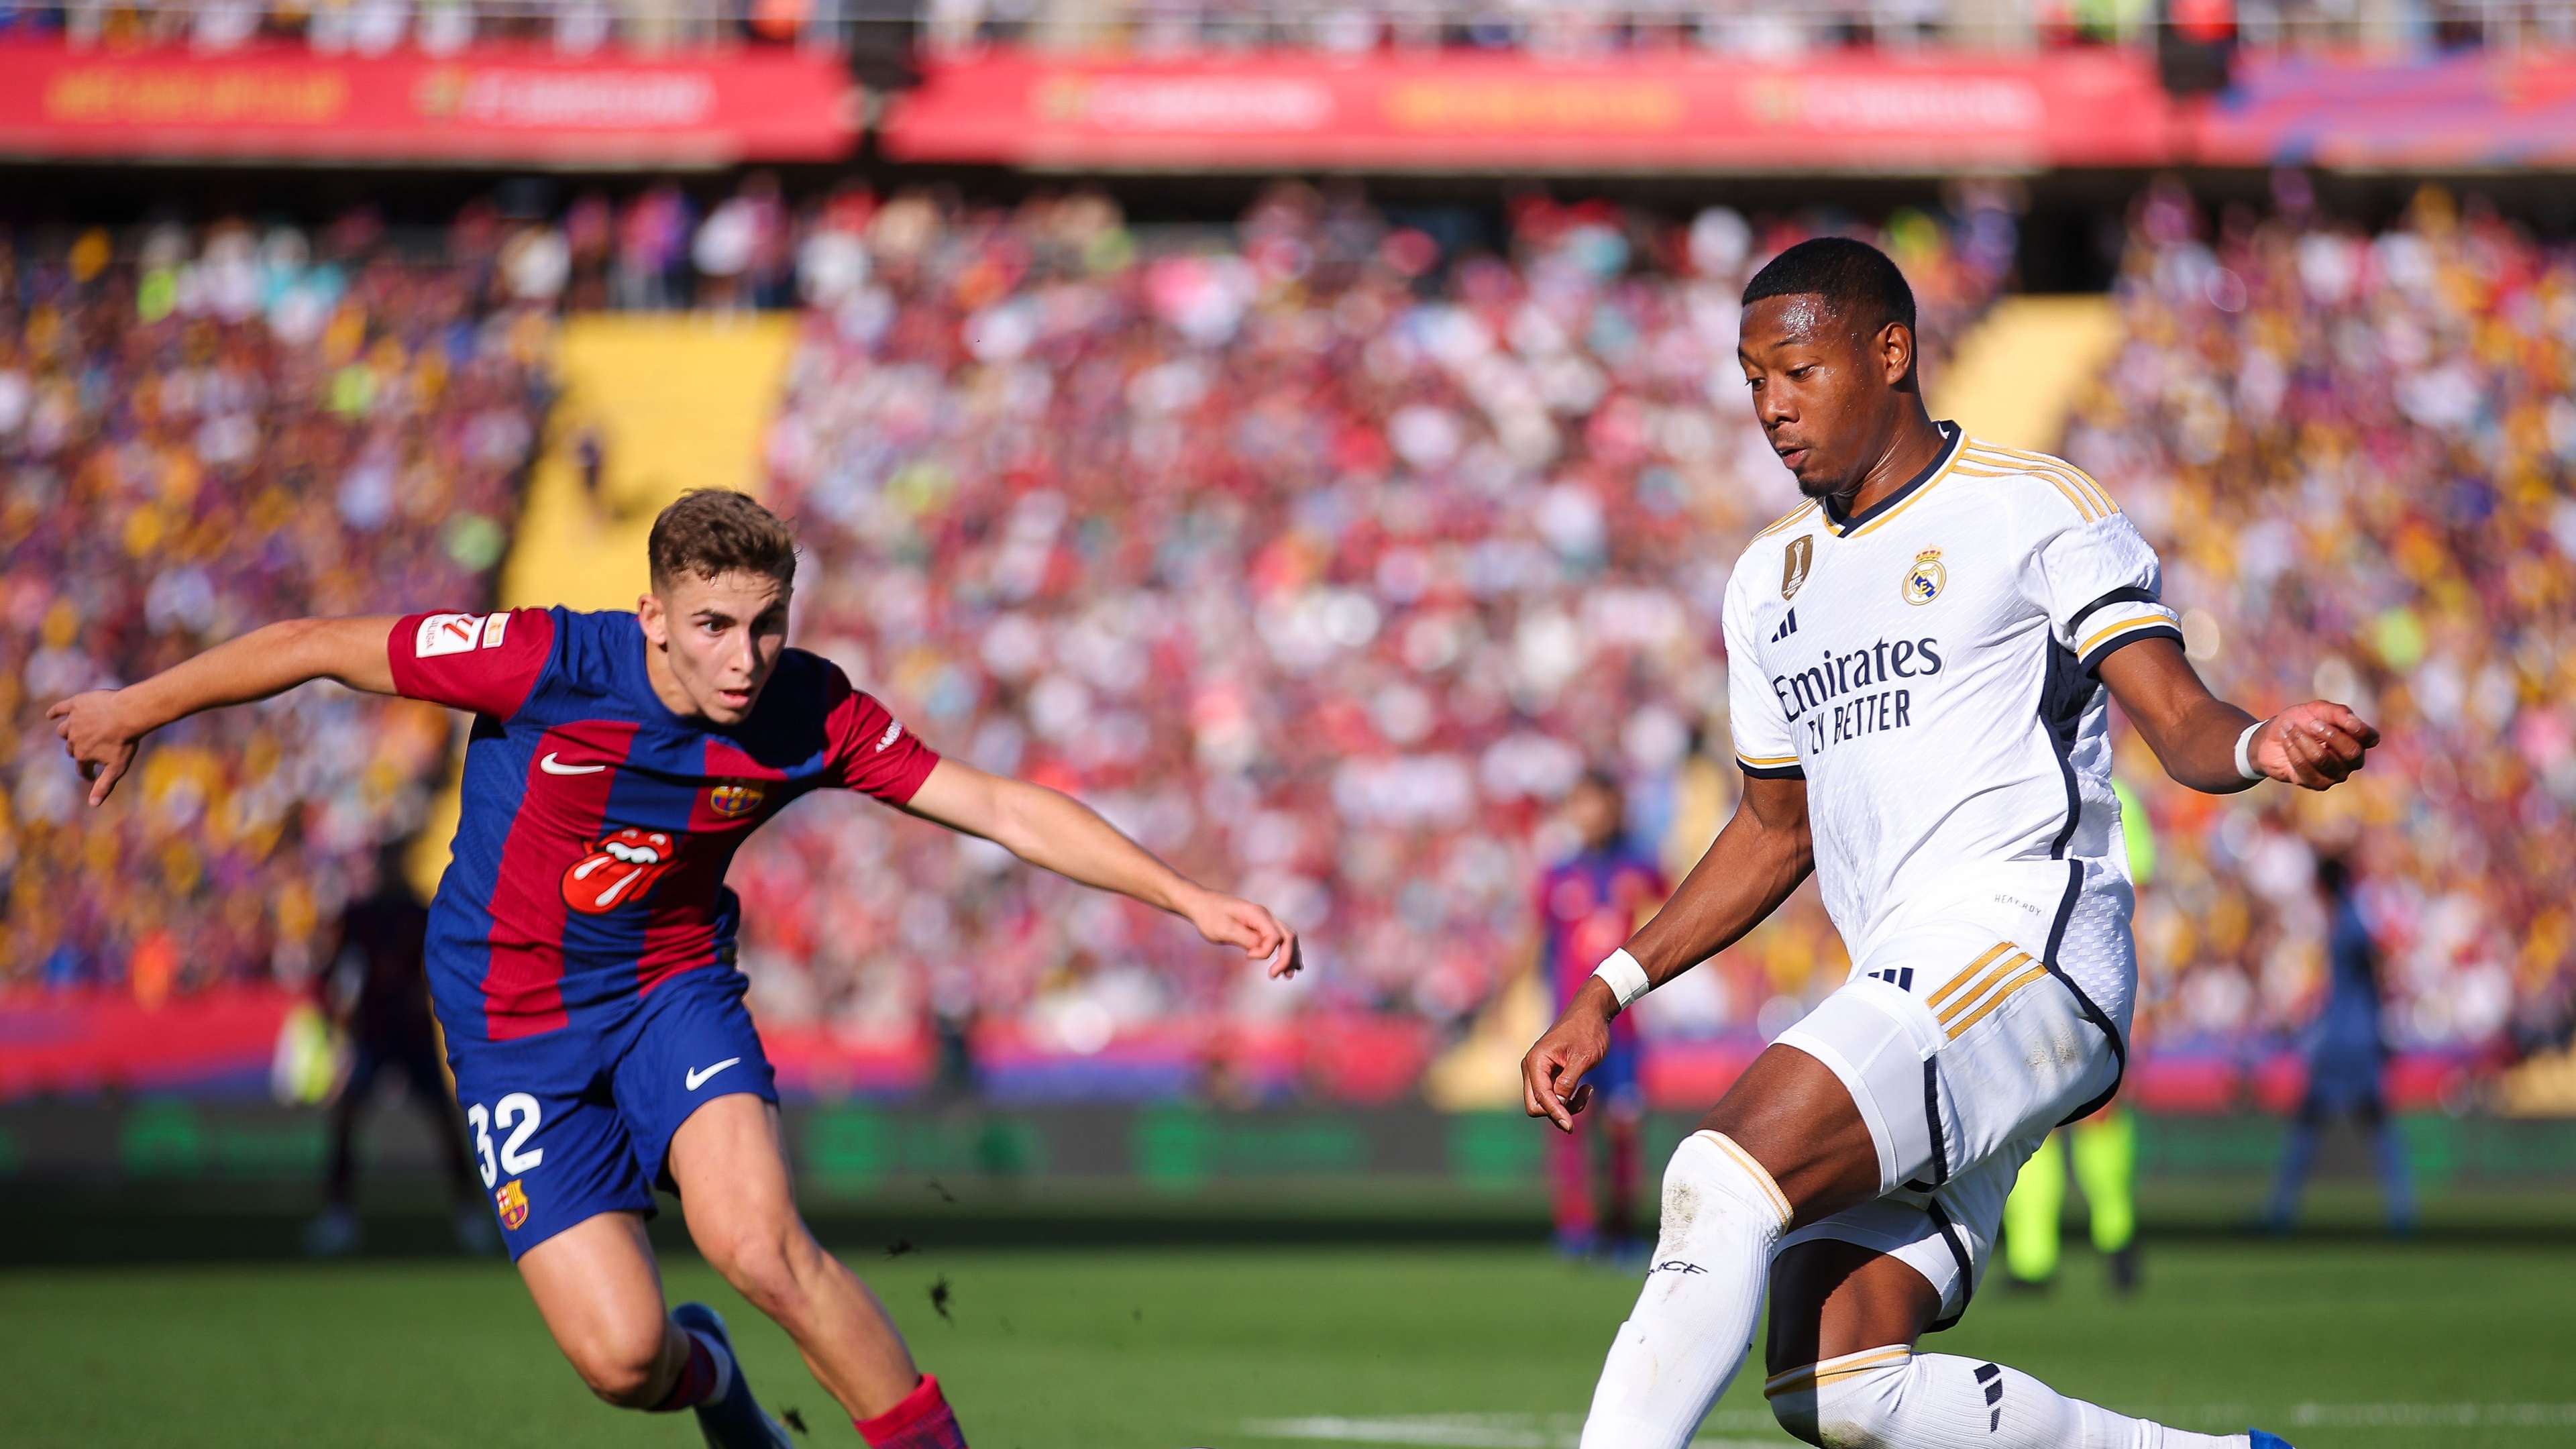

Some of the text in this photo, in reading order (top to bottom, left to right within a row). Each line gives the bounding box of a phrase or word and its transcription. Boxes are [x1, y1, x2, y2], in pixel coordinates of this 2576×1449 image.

[1773, 637, 1943, 722] Emirates
[1833, 689, 1911, 746] BETTER
[468, 1092, 545, 1189] 32
